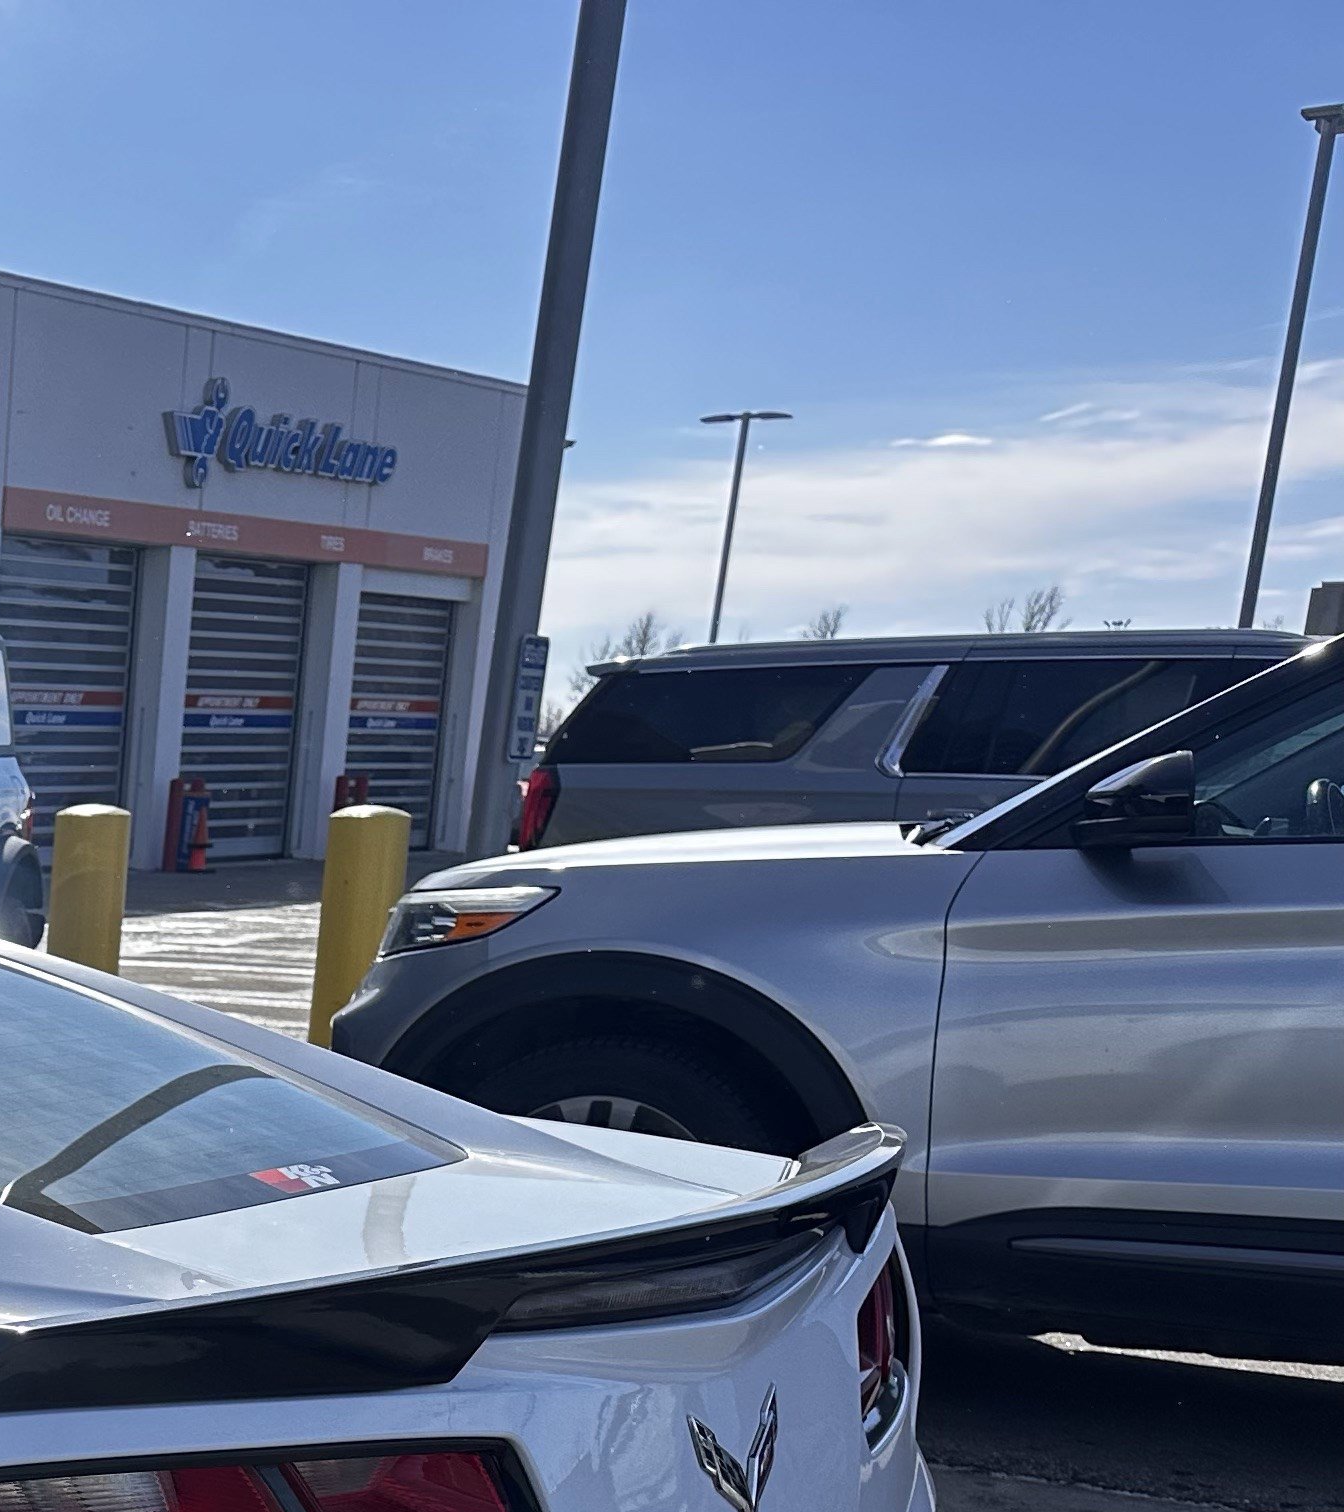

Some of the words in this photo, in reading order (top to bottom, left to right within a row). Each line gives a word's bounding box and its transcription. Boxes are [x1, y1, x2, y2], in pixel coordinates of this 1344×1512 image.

[223, 404, 323, 474] Quick
[317, 422, 398, 484] Lane
[45, 503, 65, 523] OIL
[65, 505, 111, 528] CHANGE
[188, 519, 240, 542] BATTERIES
